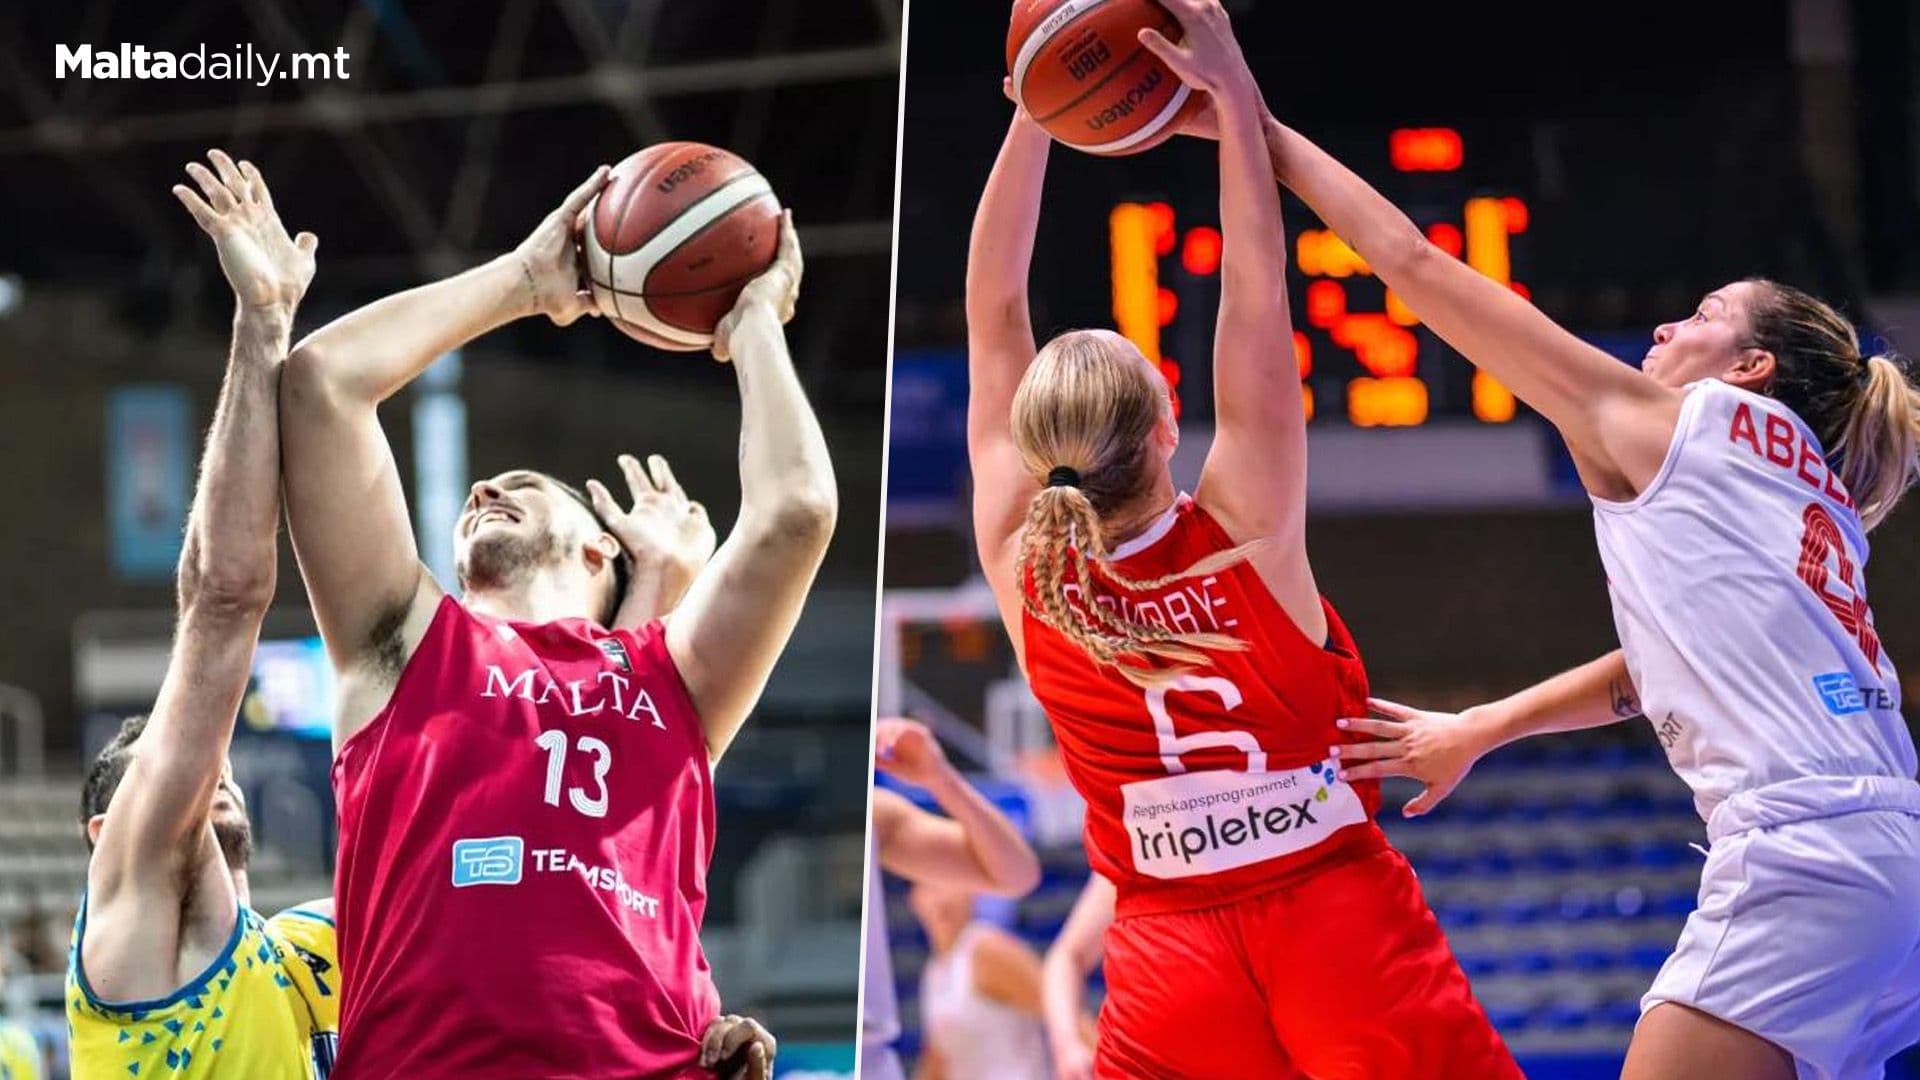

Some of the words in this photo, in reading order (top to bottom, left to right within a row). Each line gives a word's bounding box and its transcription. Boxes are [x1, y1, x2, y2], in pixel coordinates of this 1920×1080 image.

[1086, 68, 1163, 130] molten
[1144, 675, 1267, 773] 6
[534, 729, 612, 818] 13
[1132, 774, 1299, 821] Regnskapsprogrammet
[1136, 798, 1319, 864] tripletex
